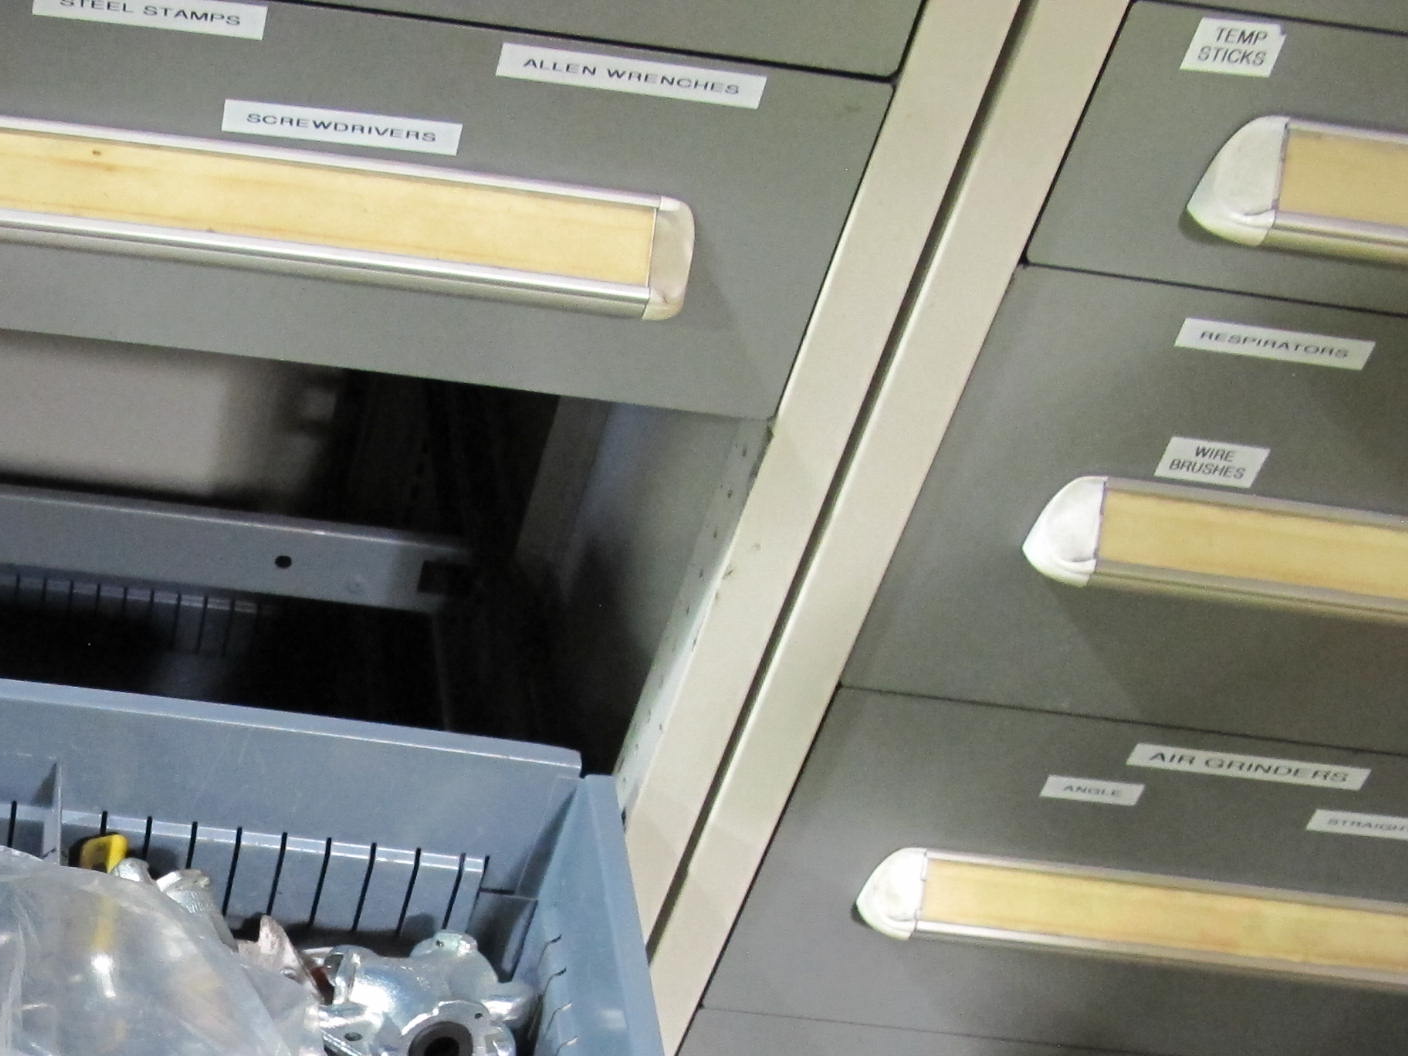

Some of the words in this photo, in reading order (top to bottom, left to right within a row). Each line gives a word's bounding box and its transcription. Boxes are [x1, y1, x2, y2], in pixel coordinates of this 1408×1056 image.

[59, 0, 134, 13] STEEL
[143, 6, 241, 26] STAMPS
[1216, 27, 1268, 46] TEMP
[1197, 46, 1266, 66] STICKS
[523, 58, 597, 76] ALLEN
[607, 68, 740, 95] WRENCHES
[246, 112, 437, 142] SCREWDRIVERS
[1199, 330, 1349, 359] RESPIRATORS
[1195, 445, 1234, 463] WIRE
[1169, 458, 1246, 480] BRUSHES
[1148, 752, 1197, 766] AIR
[1204, 758, 1349, 784] GRINDERS
[1063, 785, 1121, 797] ANGLE
[1327, 818, 1408, 833] STRAIGH
